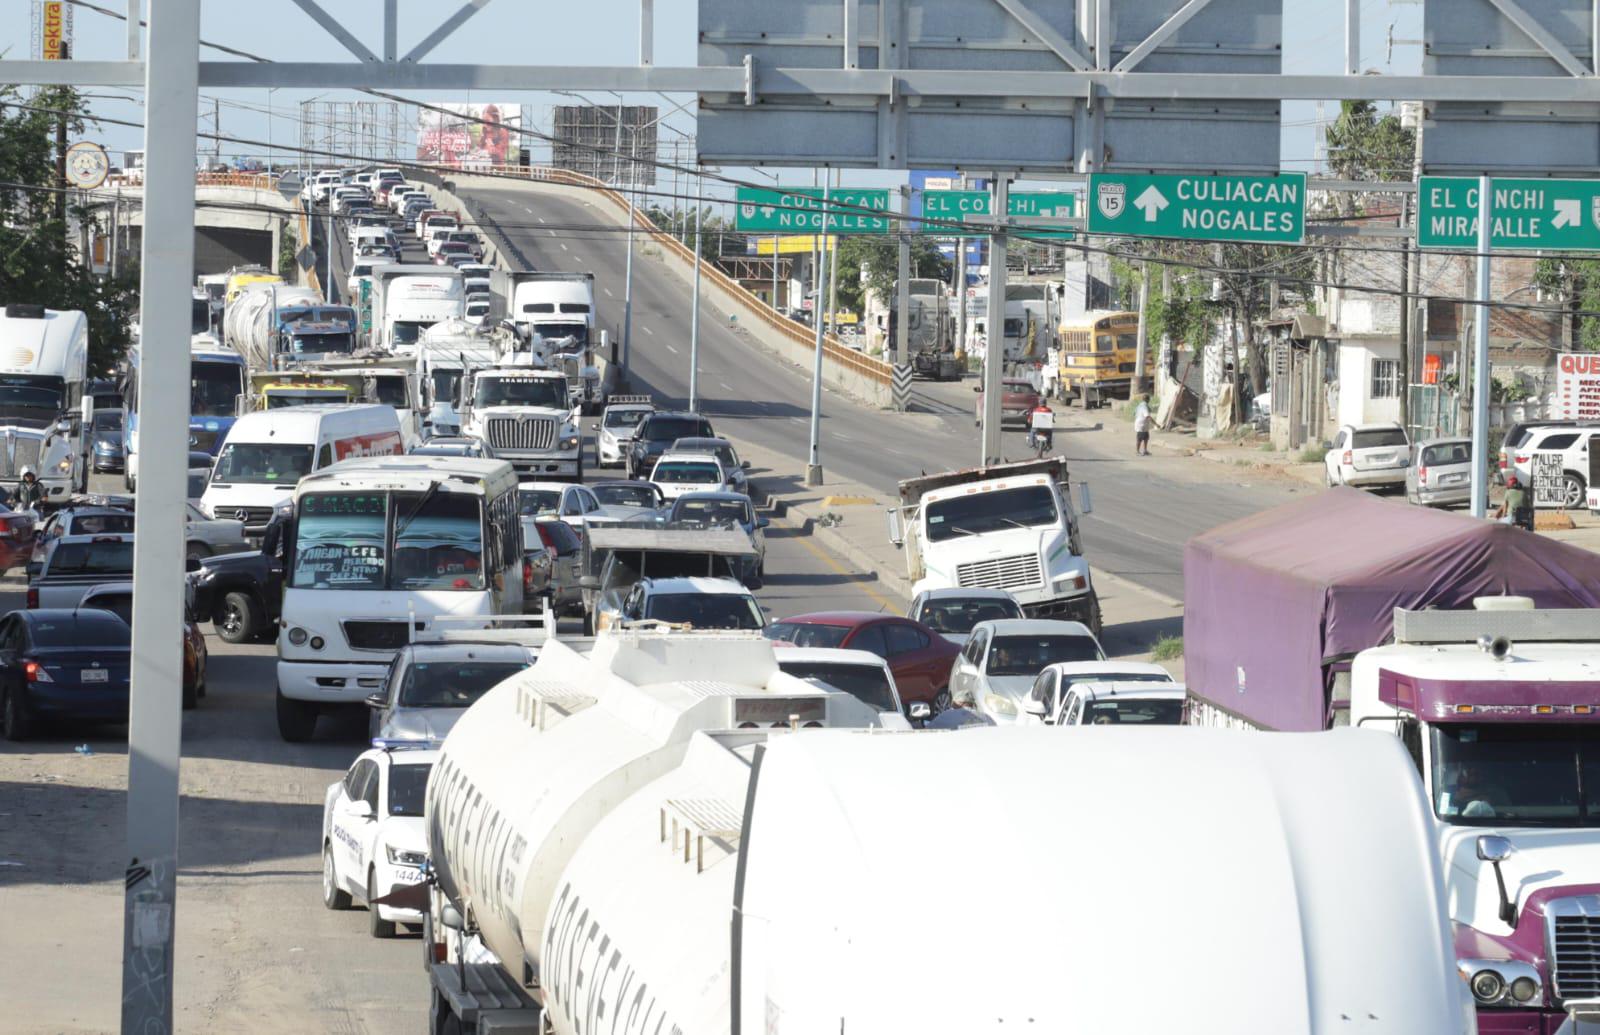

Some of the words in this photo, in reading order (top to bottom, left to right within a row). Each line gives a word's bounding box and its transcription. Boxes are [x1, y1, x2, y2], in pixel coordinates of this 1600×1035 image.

[1176, 179, 1297, 204] CULIACAN
[1431, 188, 1456, 208] EL
[1466, 189, 1544, 210] CNCHI
[780, 194, 885, 209] CULACAN
[927, 198, 950, 211] EL
[959, 198, 1036, 212] COHI
[1106, 197, 1119, 210] 15
[779, 213, 882, 229] NOGALES
[1181, 209, 1295, 232] NOGALES
[1431, 216, 1542, 238] MIRAALLE
[1532, 453, 1563, 466] TALLER
